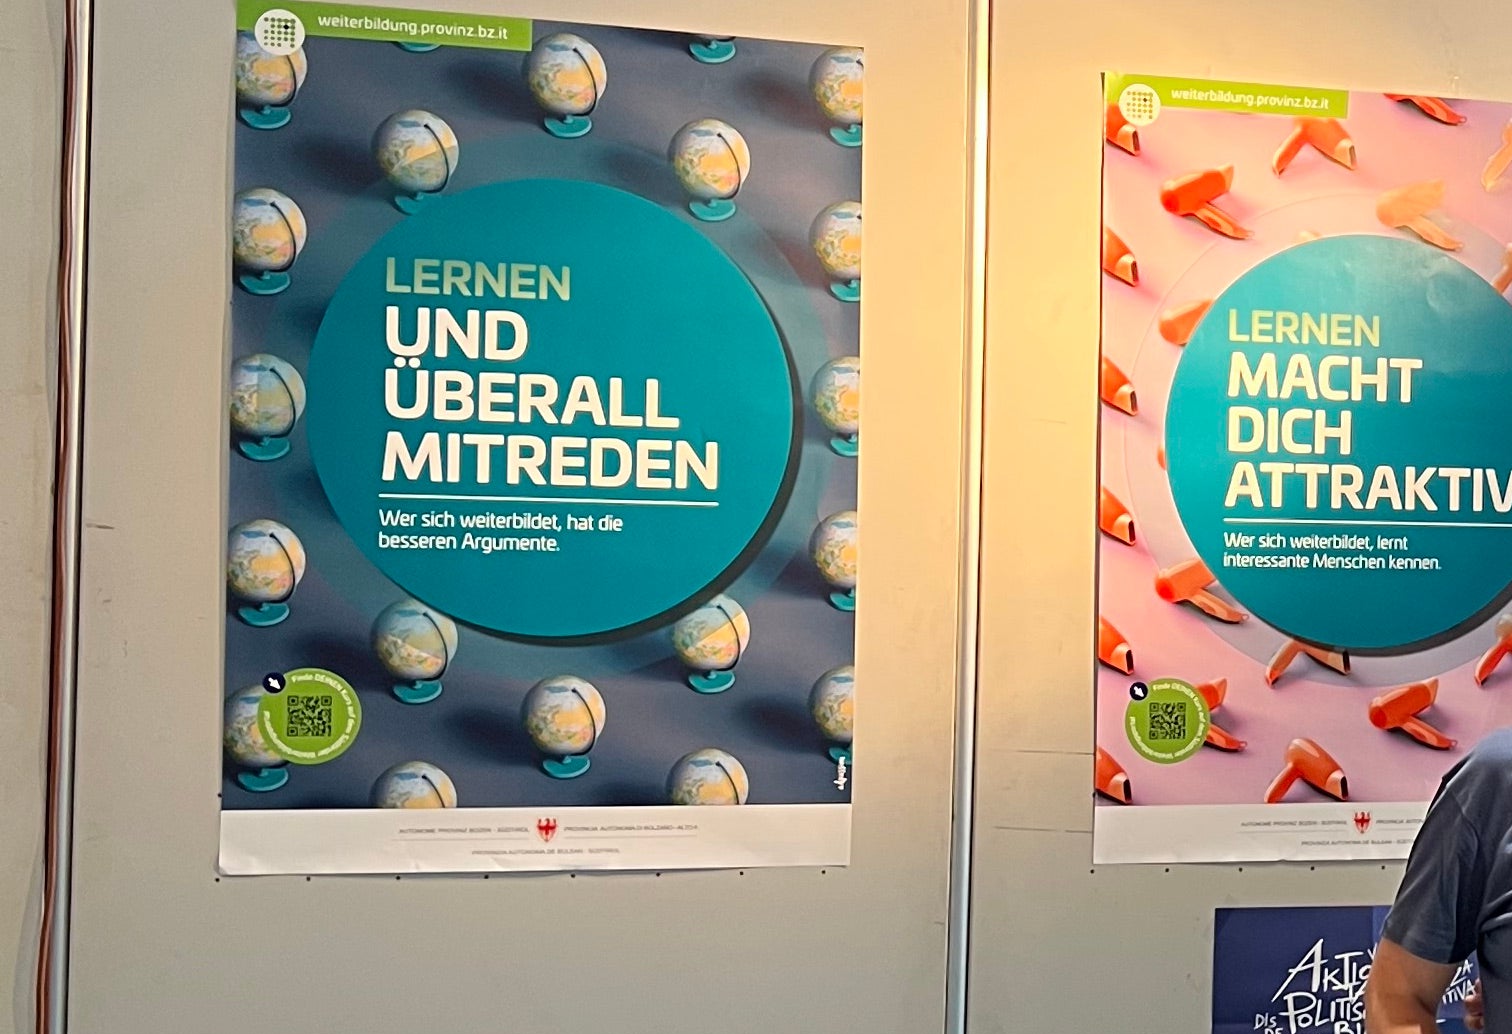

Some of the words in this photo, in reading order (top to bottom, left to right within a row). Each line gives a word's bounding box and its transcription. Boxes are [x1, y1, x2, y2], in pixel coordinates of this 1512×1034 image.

[318, 12, 508, 41] weiterbildung.provinz.bz.it
[1171, 88, 1329, 111] weiterbildung.provinz.bz.it
[386, 256, 571, 300] LERNEN
[385, 305, 529, 361] UND
[1228, 309, 1380, 347] LERNEN
[384, 356, 680, 429] ÜBERALL
[1228, 351, 1423, 403] MACHT
[1227, 405, 1352, 455] DICH
[380, 430, 719, 490] MITREDEN
[379, 508, 418, 528] Wer
[422, 509, 455, 529] sich
[459, 511, 562, 533] weiterbildet,
[567, 512, 593, 531] hat
[598, 513, 623, 532] die
[379, 531, 456, 551] besseren
[462, 532, 560, 554] Argumente.
[1224, 532, 1255, 548] Wer
[1259, 532, 1286, 549] sich
[1290, 533, 1374, 552] weiterbildet,
[1377, 534, 1408, 551] lernt
[1224, 552, 1309, 568] interessante
[1313, 553, 1385, 569] Menschen
[1388, 554, 1442, 570] kennen.
[1254, 1013, 1277, 1030] DIS
